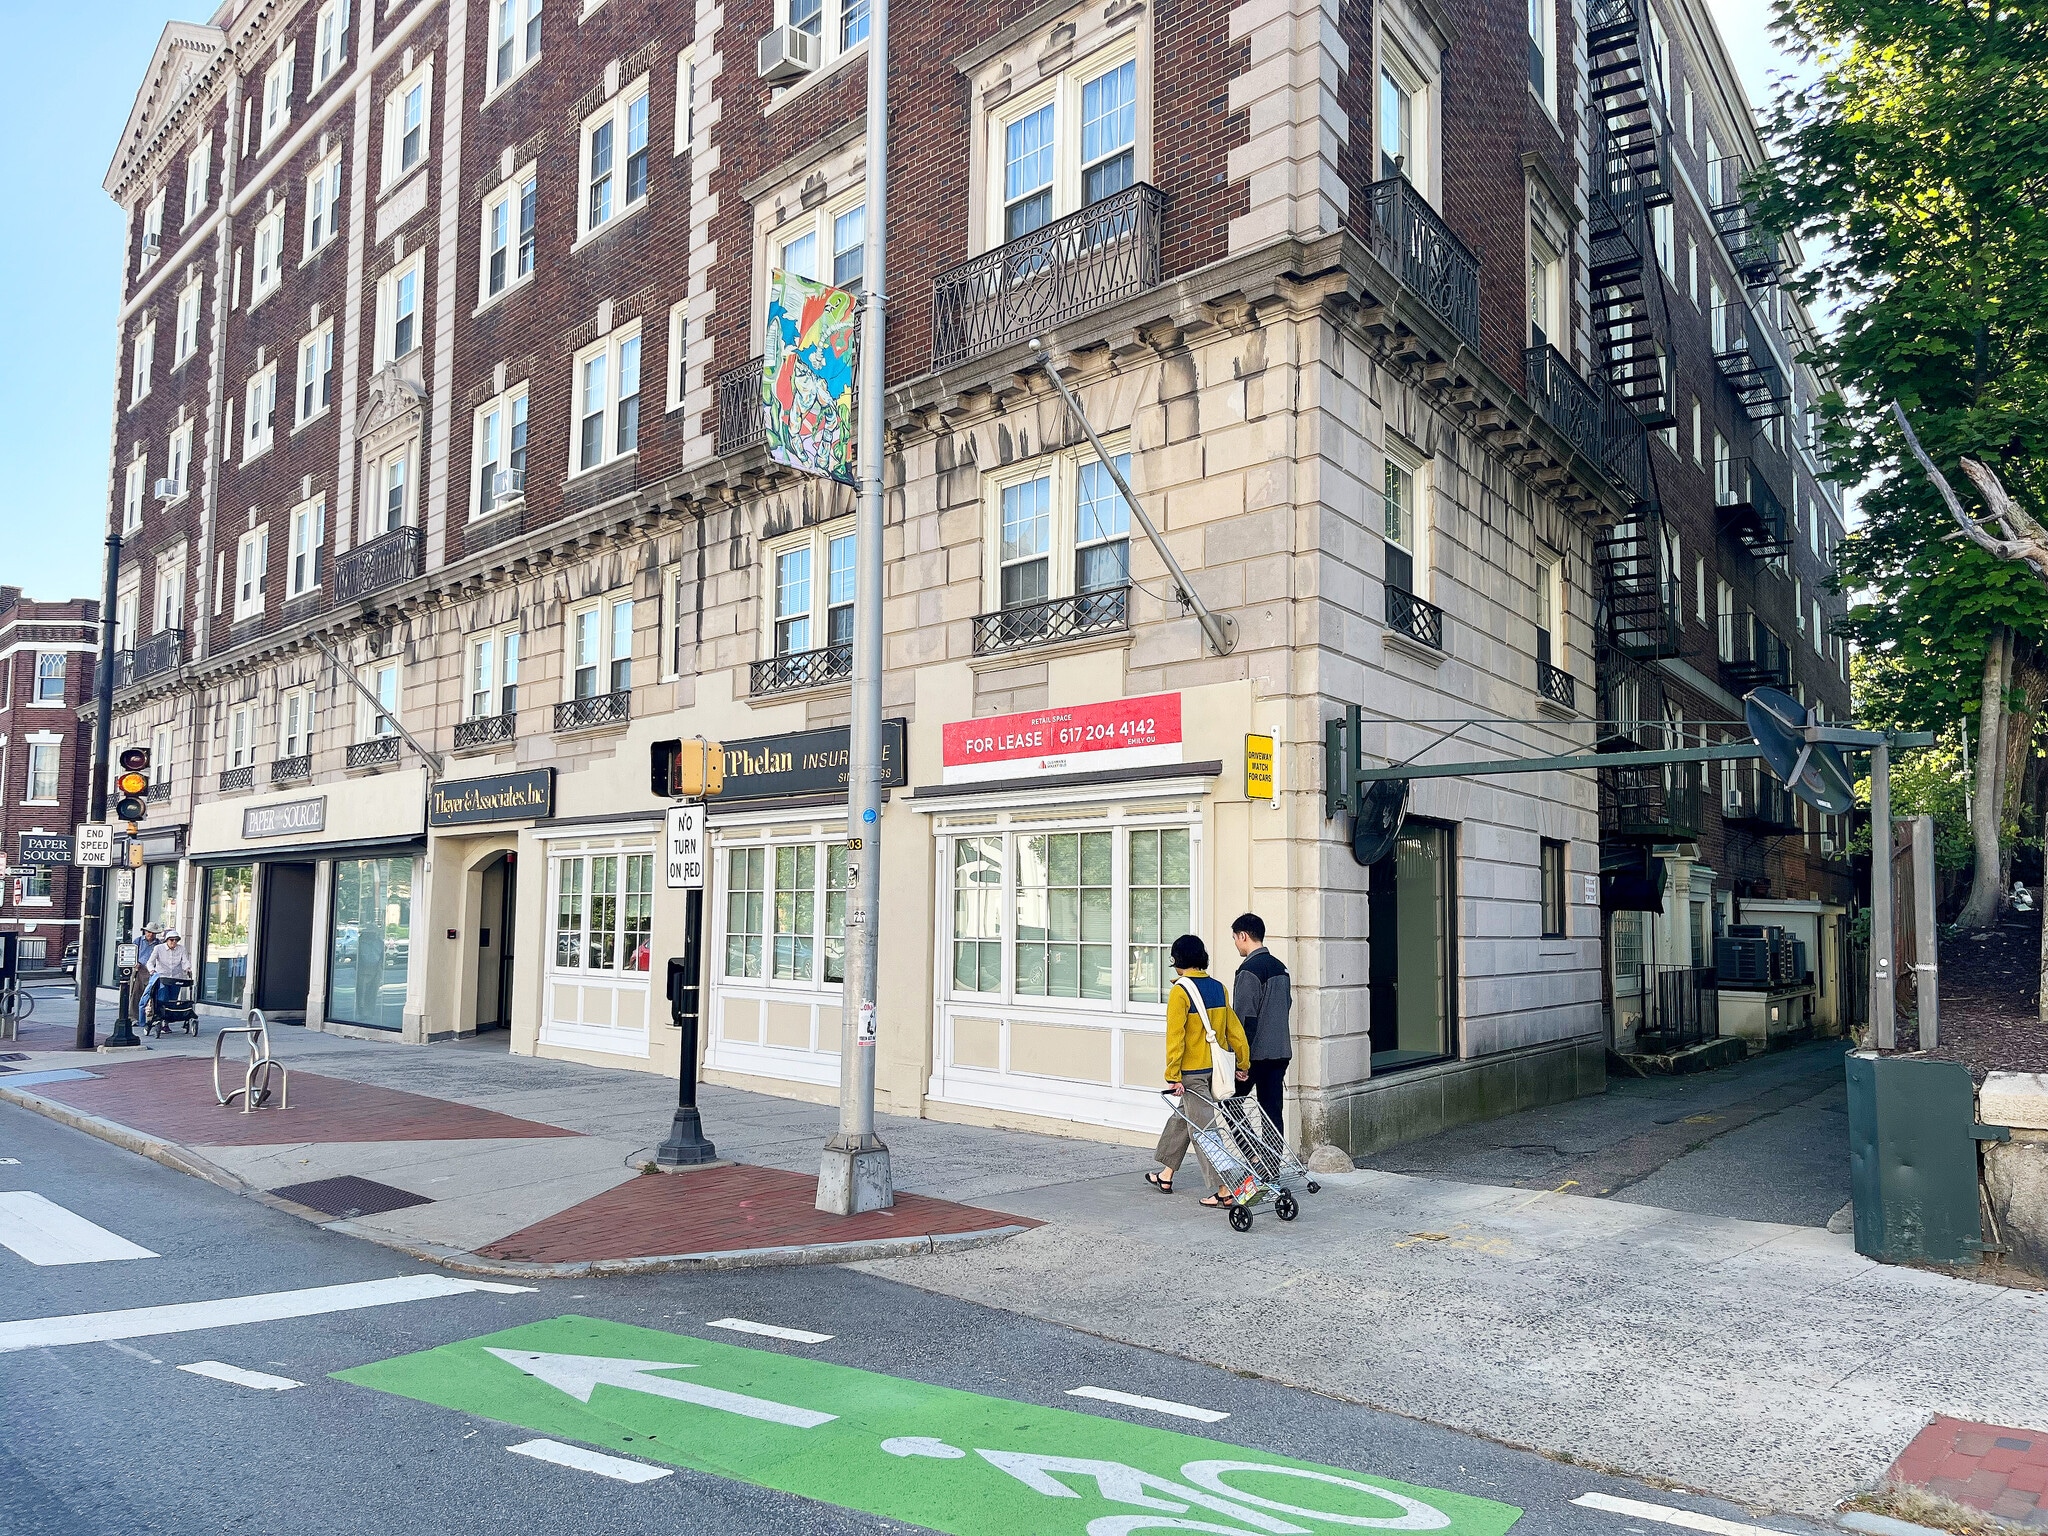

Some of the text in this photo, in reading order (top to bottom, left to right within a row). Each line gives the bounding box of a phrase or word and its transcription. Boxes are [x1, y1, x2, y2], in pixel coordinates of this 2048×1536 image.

[1032, 714, 1072, 726] RETAIL SPACE
[1060, 718, 1155, 743] 617 204 4142
[966, 731, 1042, 754] FOR LEASE
[1127, 737, 1144, 745] EMILY
[802, 744, 890, 771] INSURE
[1248, 752, 1272, 761] DRIVEWAY
[1252, 762, 1269, 771] WATCH
[1248, 773, 1272, 782] FOR CARS
[248, 802, 320, 832] PAPER SOURCE
[678, 815, 693, 832] NO
[86, 829, 104, 838] END
[28, 838, 68, 850] PAPER
[80, 841, 109, 850] SPEED
[674, 839, 697, 855] TURN
[23, 850, 72, 861] SOURCE
[82, 852, 106, 861] ZONE
[670, 862, 700, 879] ON RED
